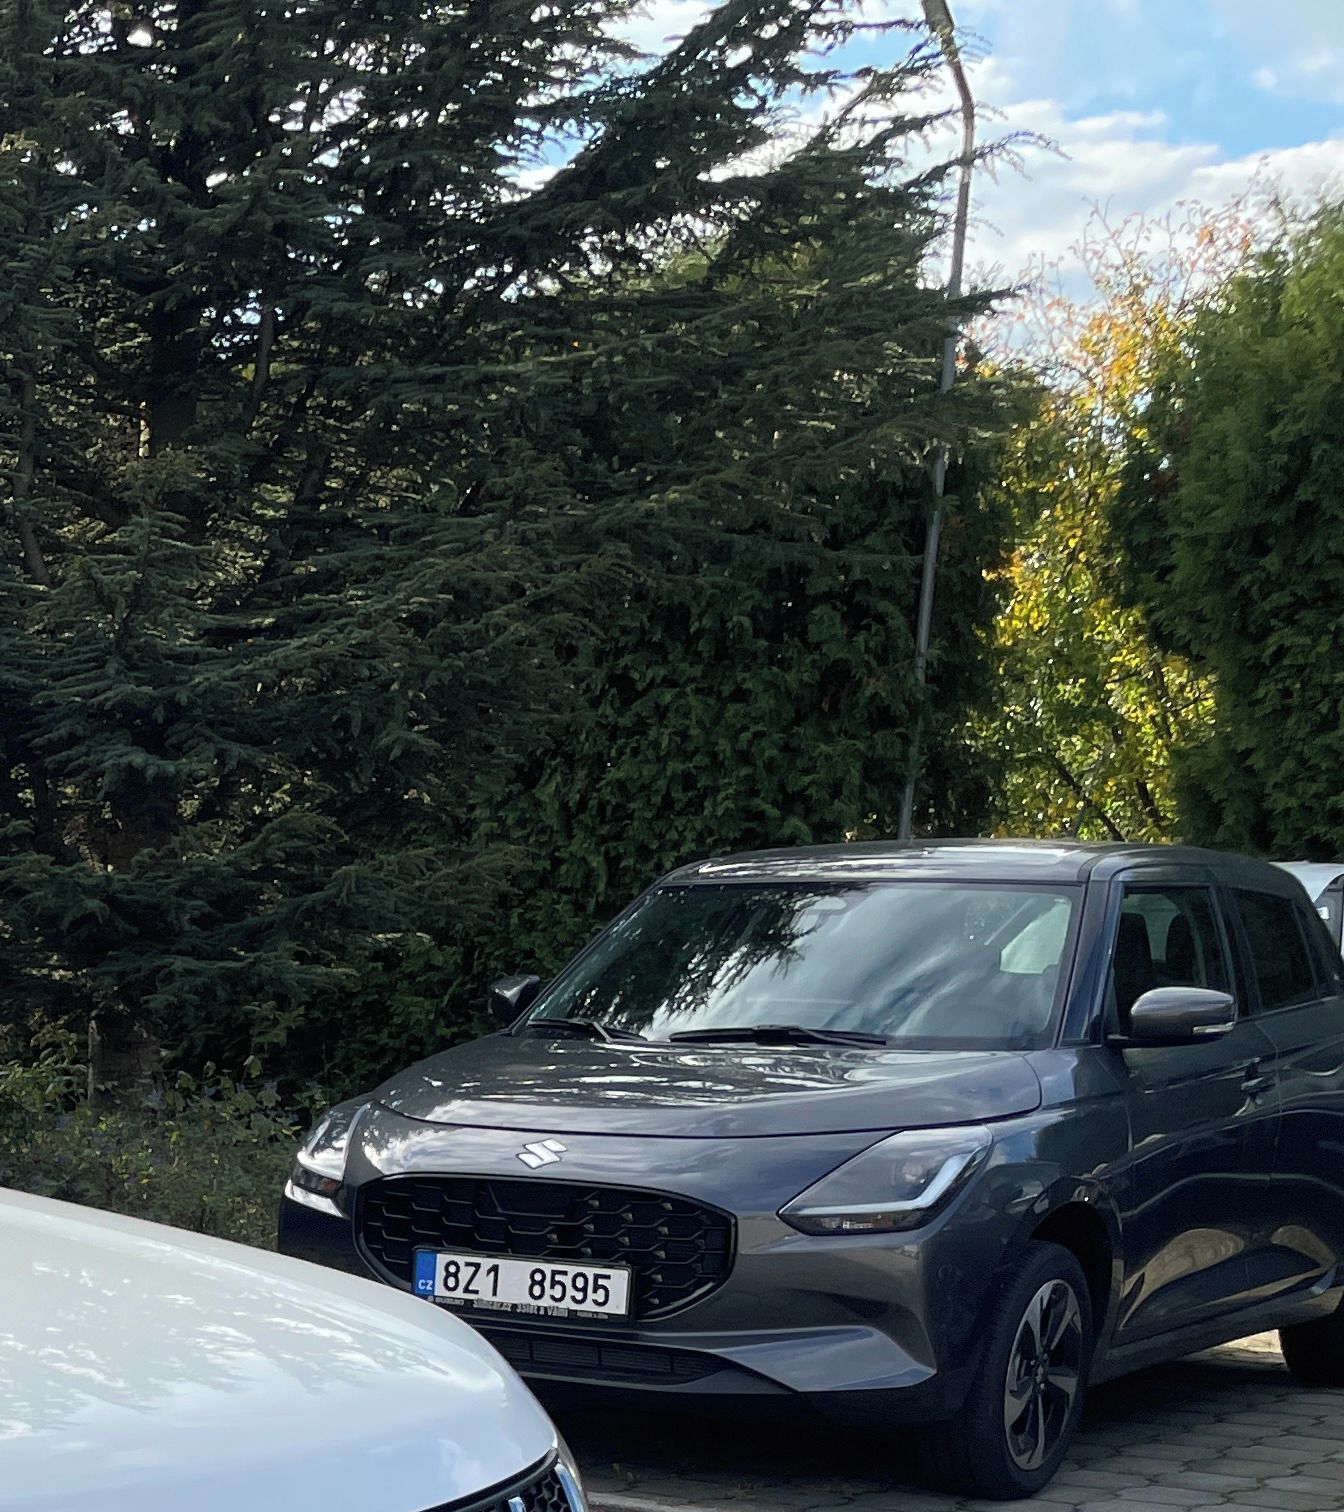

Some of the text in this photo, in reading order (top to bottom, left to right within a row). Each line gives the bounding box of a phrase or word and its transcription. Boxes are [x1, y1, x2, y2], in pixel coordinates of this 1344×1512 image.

[418, 1278, 433, 1291] CZ
[443, 1259, 612, 1308] 8Z1 8595
